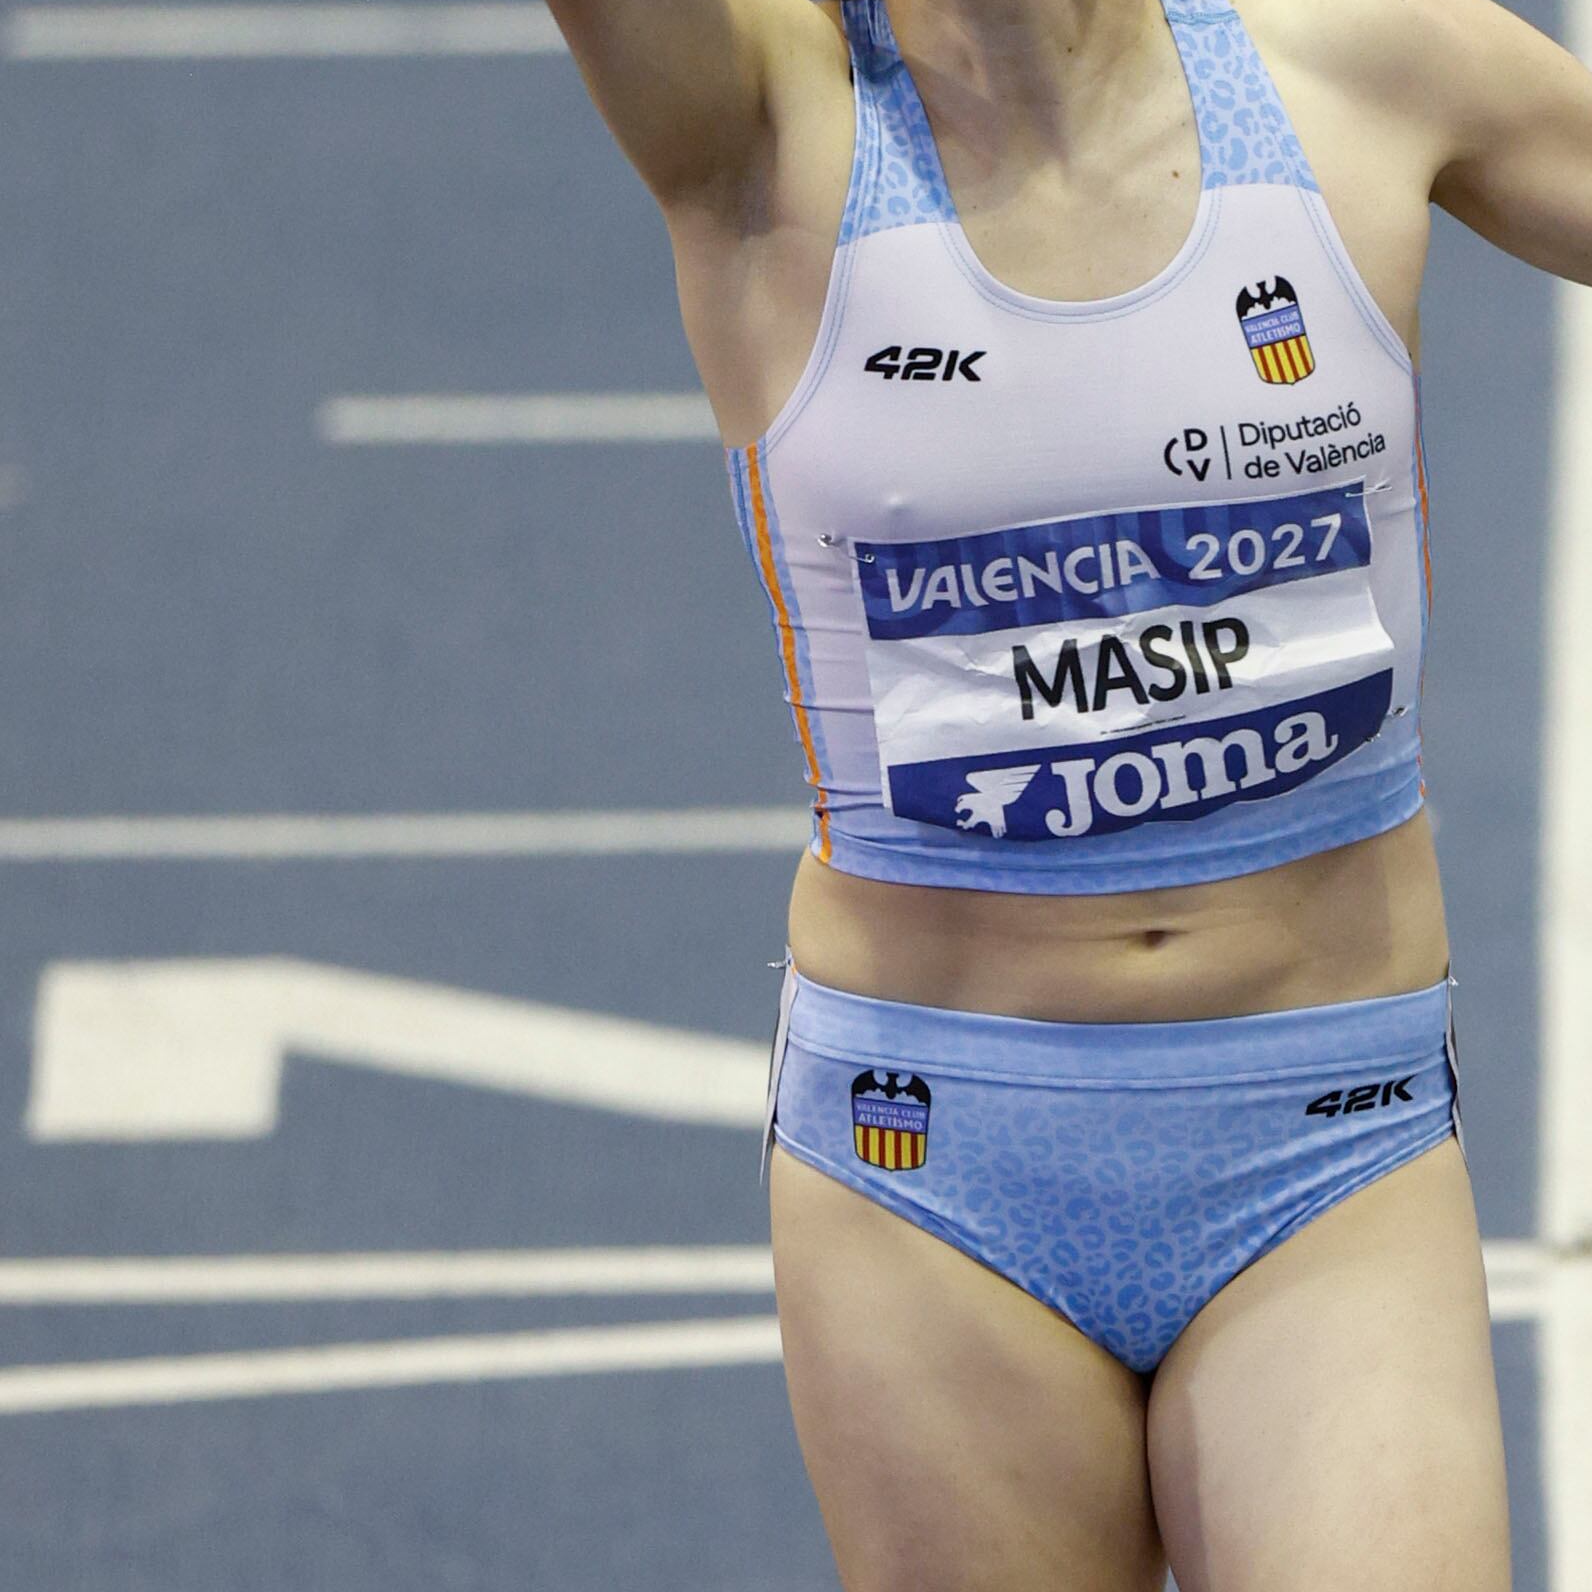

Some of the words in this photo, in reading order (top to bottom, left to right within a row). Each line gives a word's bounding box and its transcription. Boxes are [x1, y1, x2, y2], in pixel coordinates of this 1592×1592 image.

[864, 345, 988, 382] 42K
[1238, 401, 1362, 451] Diputació
[1244, 455, 1281, 480] de
[1285, 431, 1386, 477] València
[886, 540, 1161, 613] VALENCIA
[1185, 513, 1344, 581] 2027
[1012, 616, 1251, 721] MASIP
[1045, 710, 1339, 838] Joma
[1304, 1073, 1420, 1119] 42K
